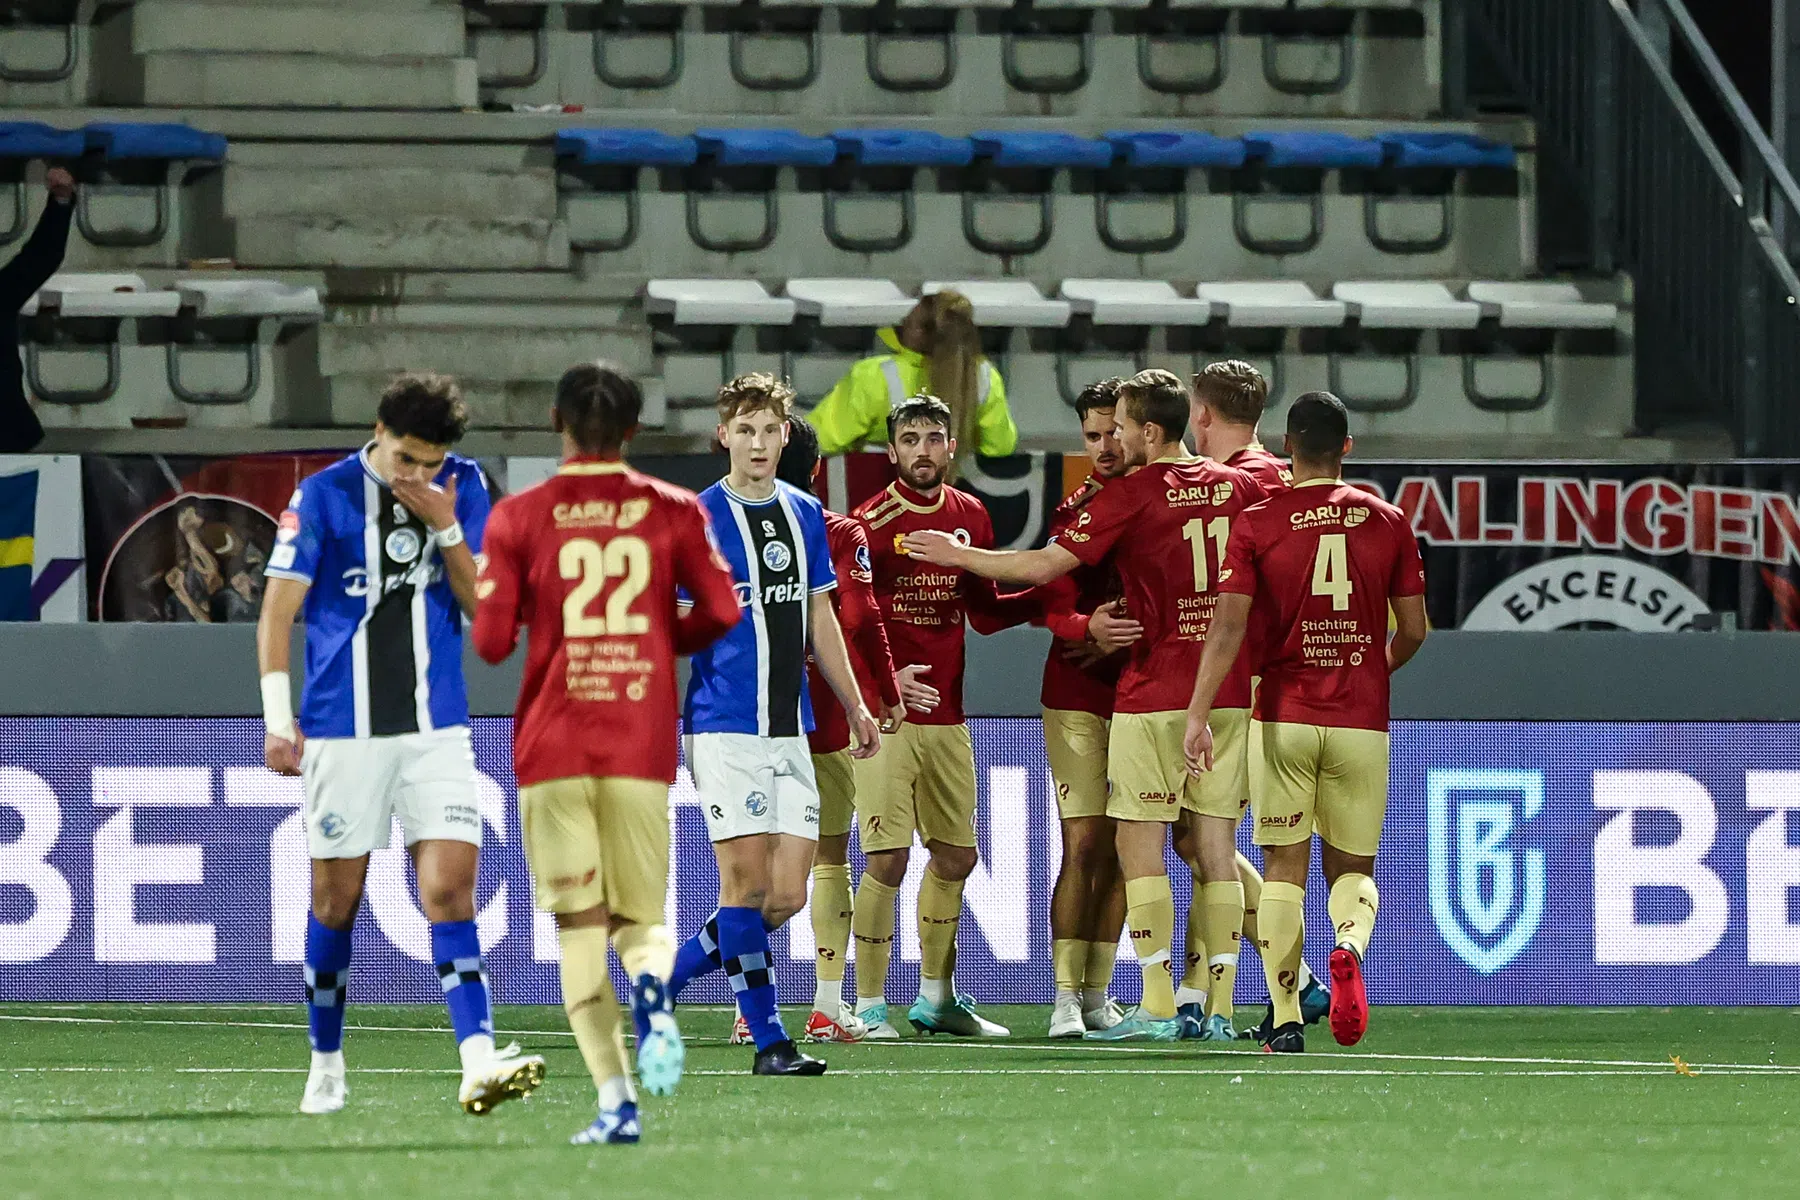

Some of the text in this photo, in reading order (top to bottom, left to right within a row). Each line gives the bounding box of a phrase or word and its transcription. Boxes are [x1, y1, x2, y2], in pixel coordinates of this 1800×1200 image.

[1166, 485, 1210, 502] CARU
[1290, 505, 1341, 525] CARU
[1347, 476, 1800, 566] ALINGEN
[1291, 519, 1341, 531] CONTAINERS
[1182, 516, 1230, 593] 11
[1311, 533, 1353, 612] 4
[558, 535, 651, 638] 22
[732, 576, 808, 608] D-reiz
[1504, 570, 1694, 630] EXCELSI
[1301, 618, 1358, 632] Stichting
[1302, 632, 1372, 645] Ambulance
[1303, 647, 1338, 658] Wens
[1139, 791, 1166, 800] CARU
[1260, 816, 1288, 825] CARU
